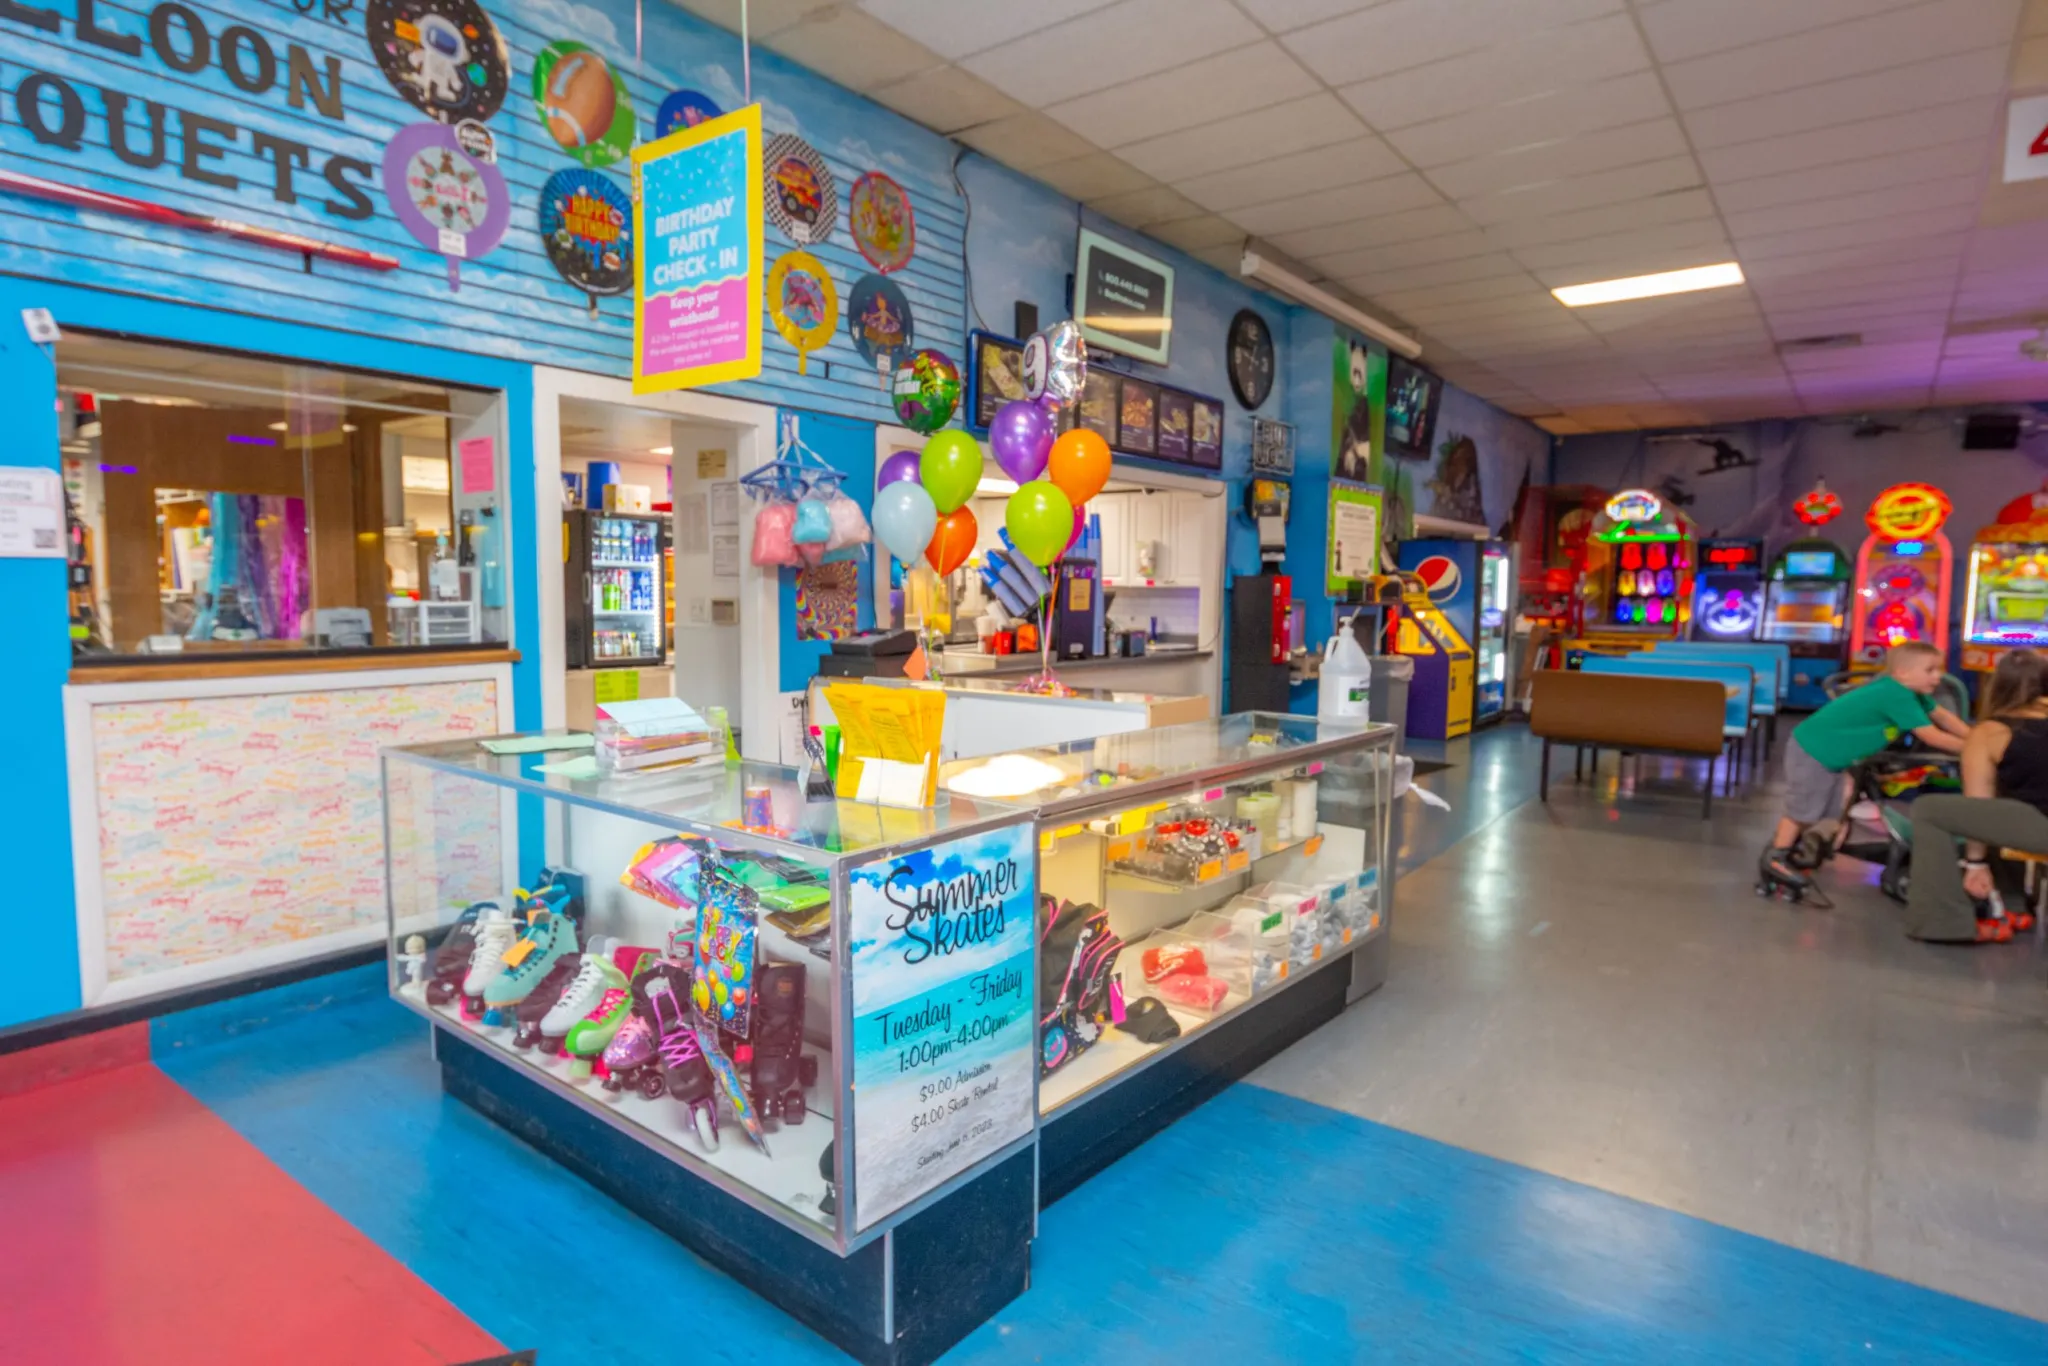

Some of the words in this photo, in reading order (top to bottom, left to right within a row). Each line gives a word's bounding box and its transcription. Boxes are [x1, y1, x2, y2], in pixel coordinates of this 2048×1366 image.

[655, 196, 735, 238] BIRTHDAY
[668, 225, 719, 258] PARTY
[653, 254, 708, 286] CHECK
[719, 245, 738, 269] IN
[670, 295, 694, 310] Keep
[696, 290, 718, 308] your
[885, 858, 1018, 930] Summer
[903, 898, 1005, 964] Skates
[874, 999, 951, 1045] Tuesday
[970, 968, 1022, 1006] Friday
[900, 1014, 1010, 1073] 1:00pm-4:00pm
[911, 1105, 945, 1134] $4.00
[948, 1095, 970, 1115] Skate
[972, 1076, 999, 1101] Rental
[919, 1076, 953, 1103] $9.00
[953, 1062, 993, 1091] Admission
